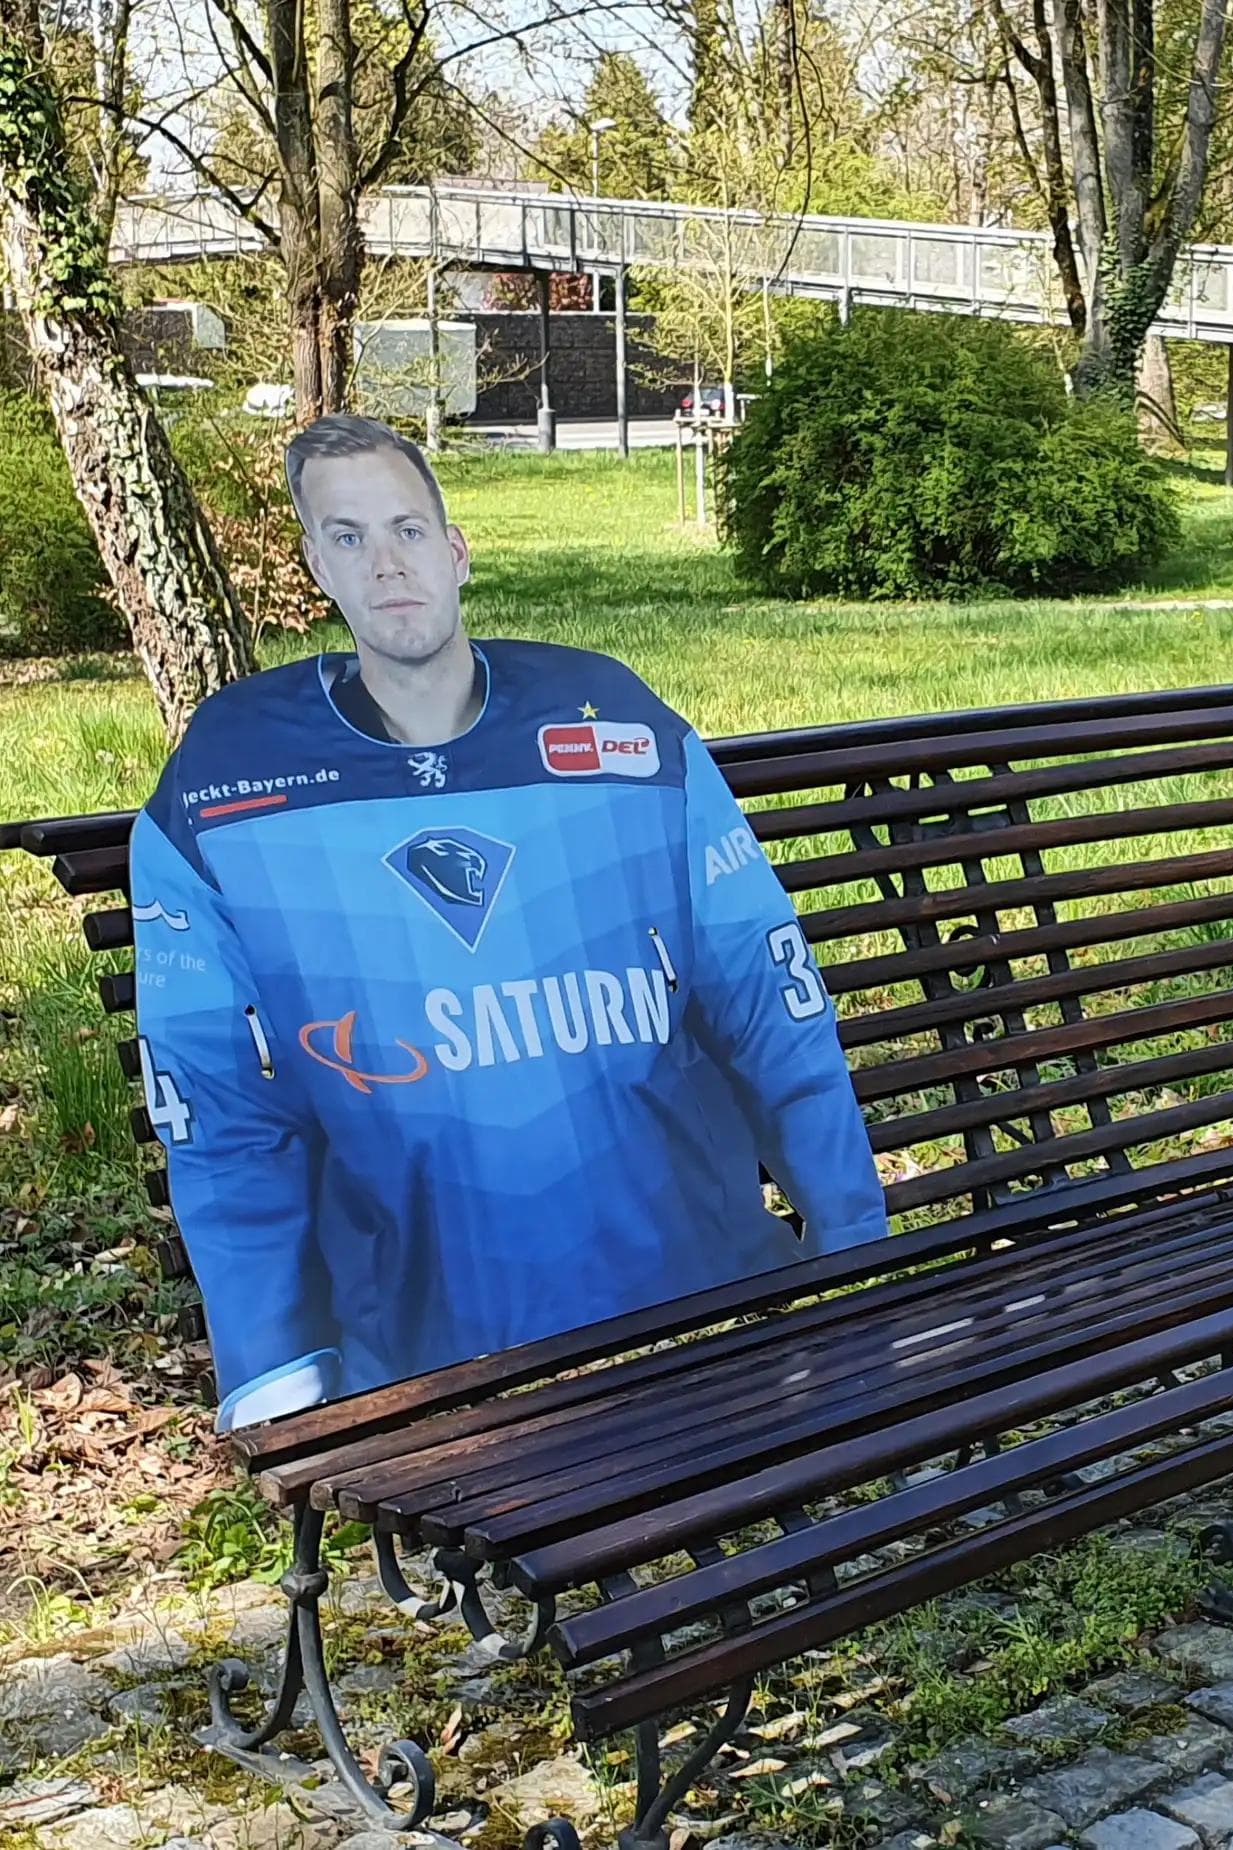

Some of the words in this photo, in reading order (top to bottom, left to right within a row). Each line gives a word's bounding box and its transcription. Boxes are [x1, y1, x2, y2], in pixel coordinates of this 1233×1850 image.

[602, 737, 649, 755] DEL
[156, 950, 176, 967] of
[180, 953, 206, 972] the
[768, 923, 826, 1019] 3
[425, 967, 670, 1072] SATURN
[139, 1037, 190, 1141] 4
